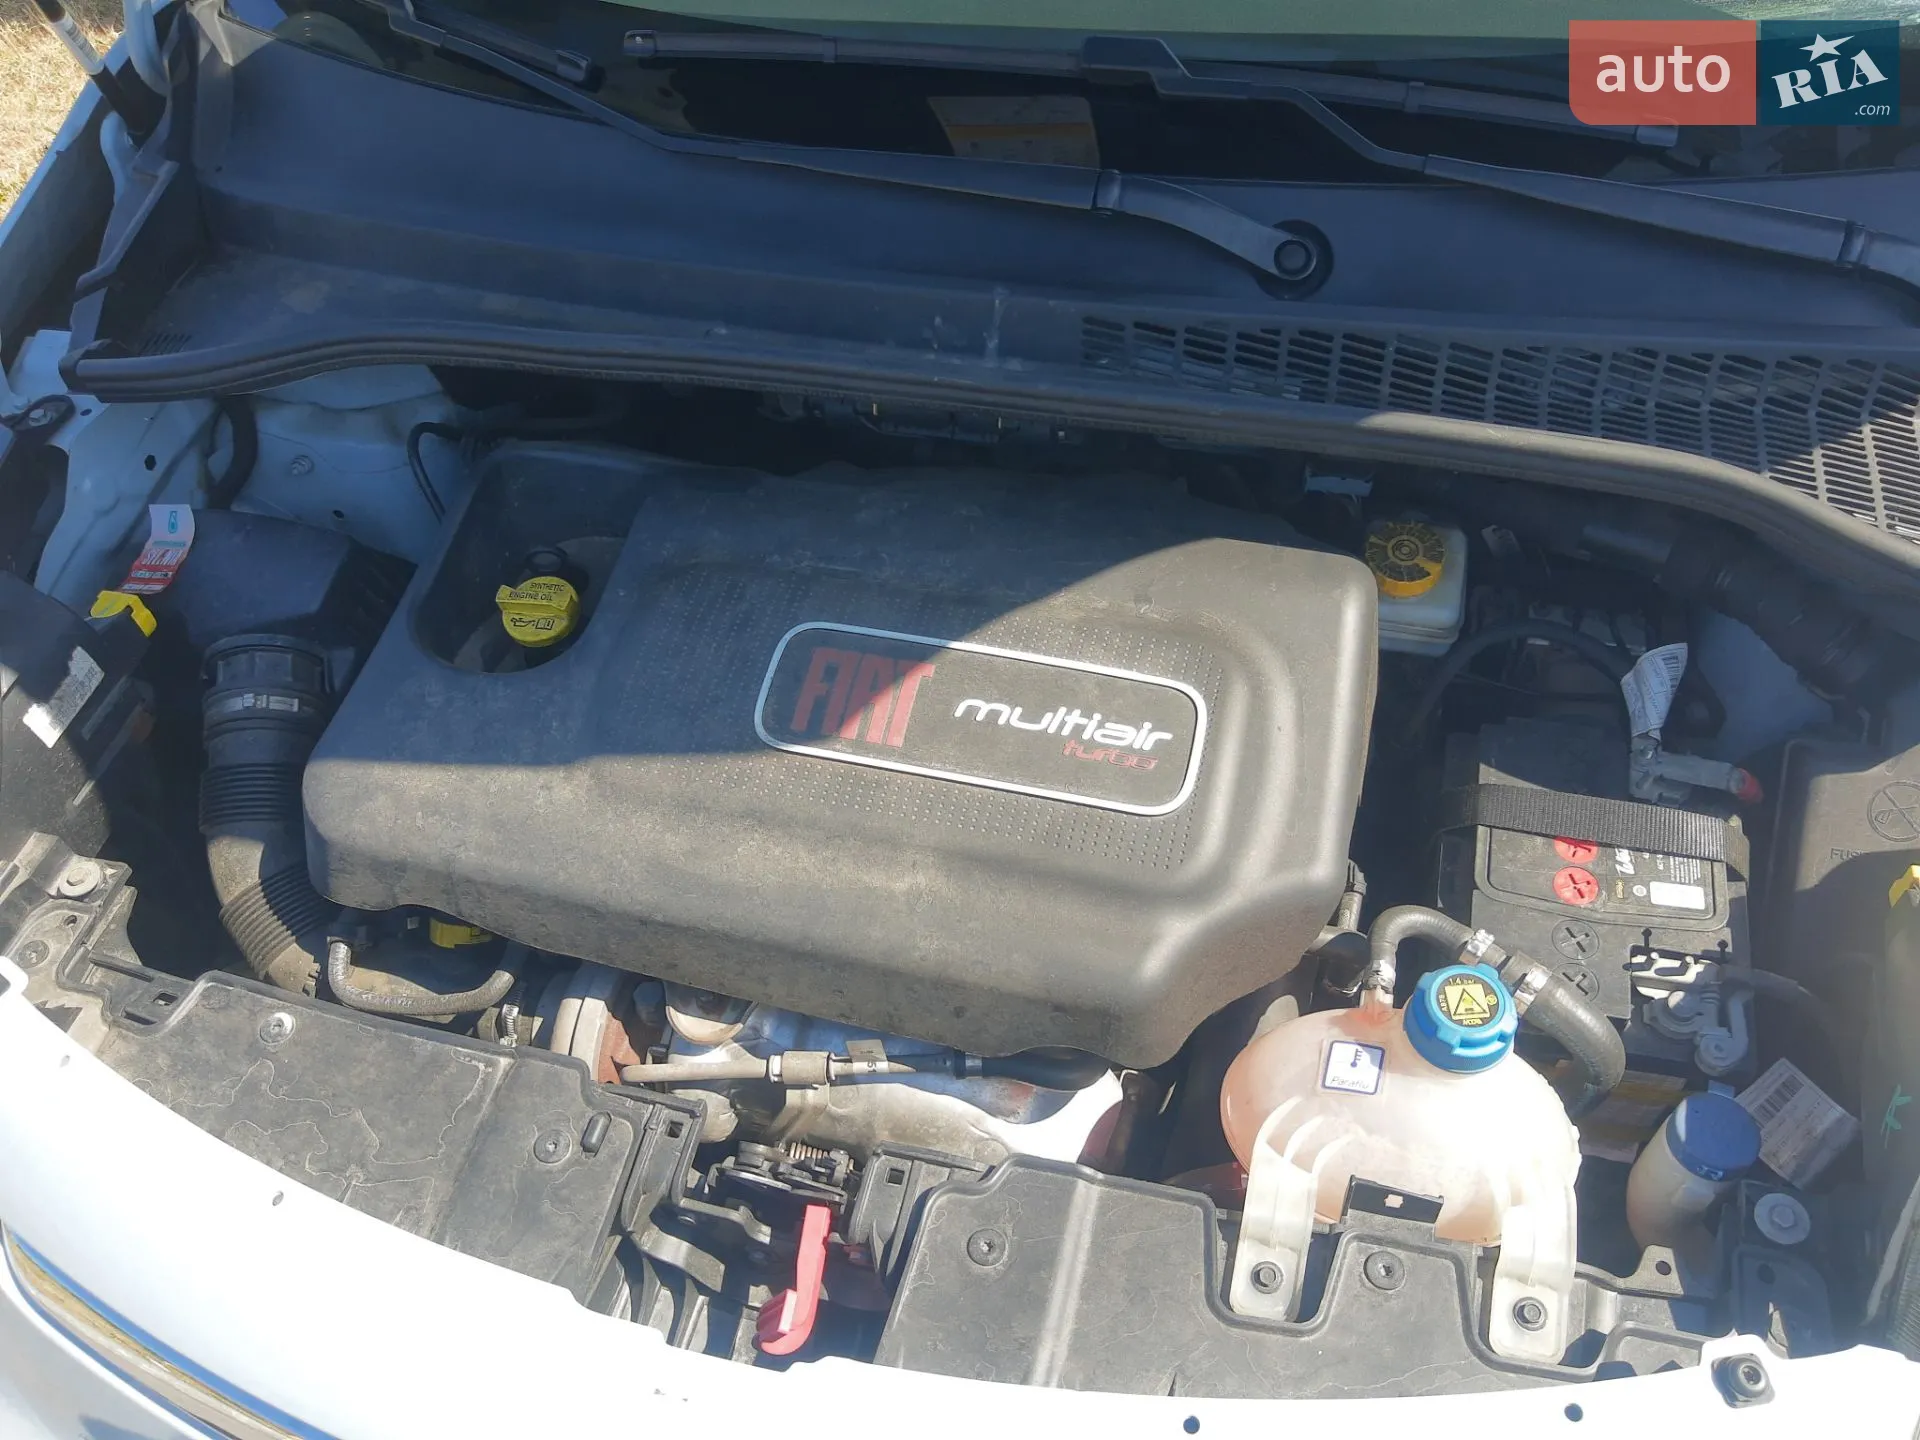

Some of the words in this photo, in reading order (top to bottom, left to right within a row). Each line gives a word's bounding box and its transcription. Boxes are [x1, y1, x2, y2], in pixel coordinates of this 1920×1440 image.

[508, 591, 538, 600] ENGINE
[540, 592, 553, 601] OIL
[529, 582, 565, 592] SYNTHETIC
[789, 647, 936, 748] FIAT
[953, 699, 1174, 750] multiair
[1062, 739, 1159, 770] turbo
